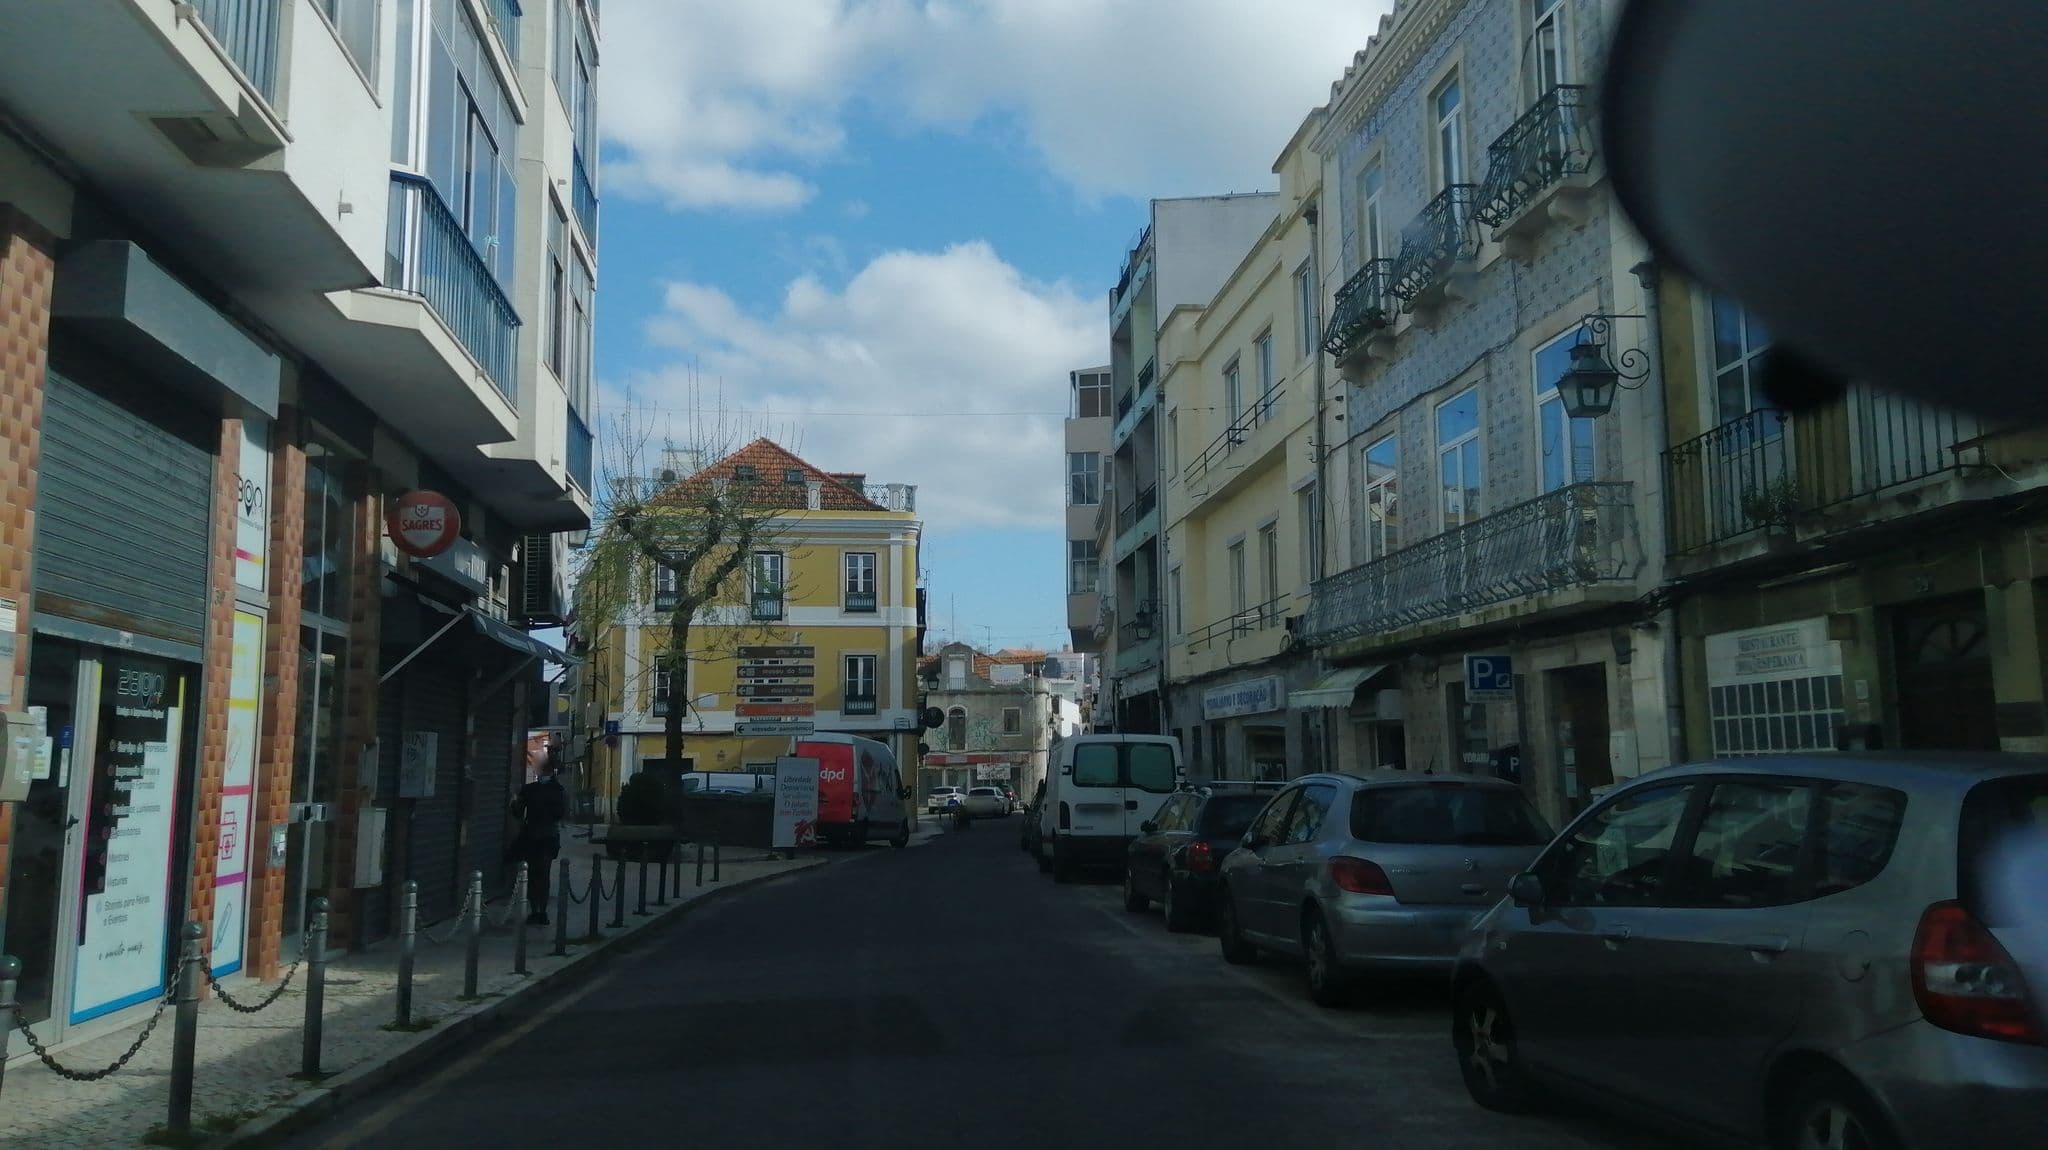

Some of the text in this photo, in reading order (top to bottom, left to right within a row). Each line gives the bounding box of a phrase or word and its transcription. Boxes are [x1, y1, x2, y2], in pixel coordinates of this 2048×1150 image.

[402, 519, 442, 532] SAGRES
[1472, 658, 1494, 689] P
[820, 768, 845, 783] dpd
